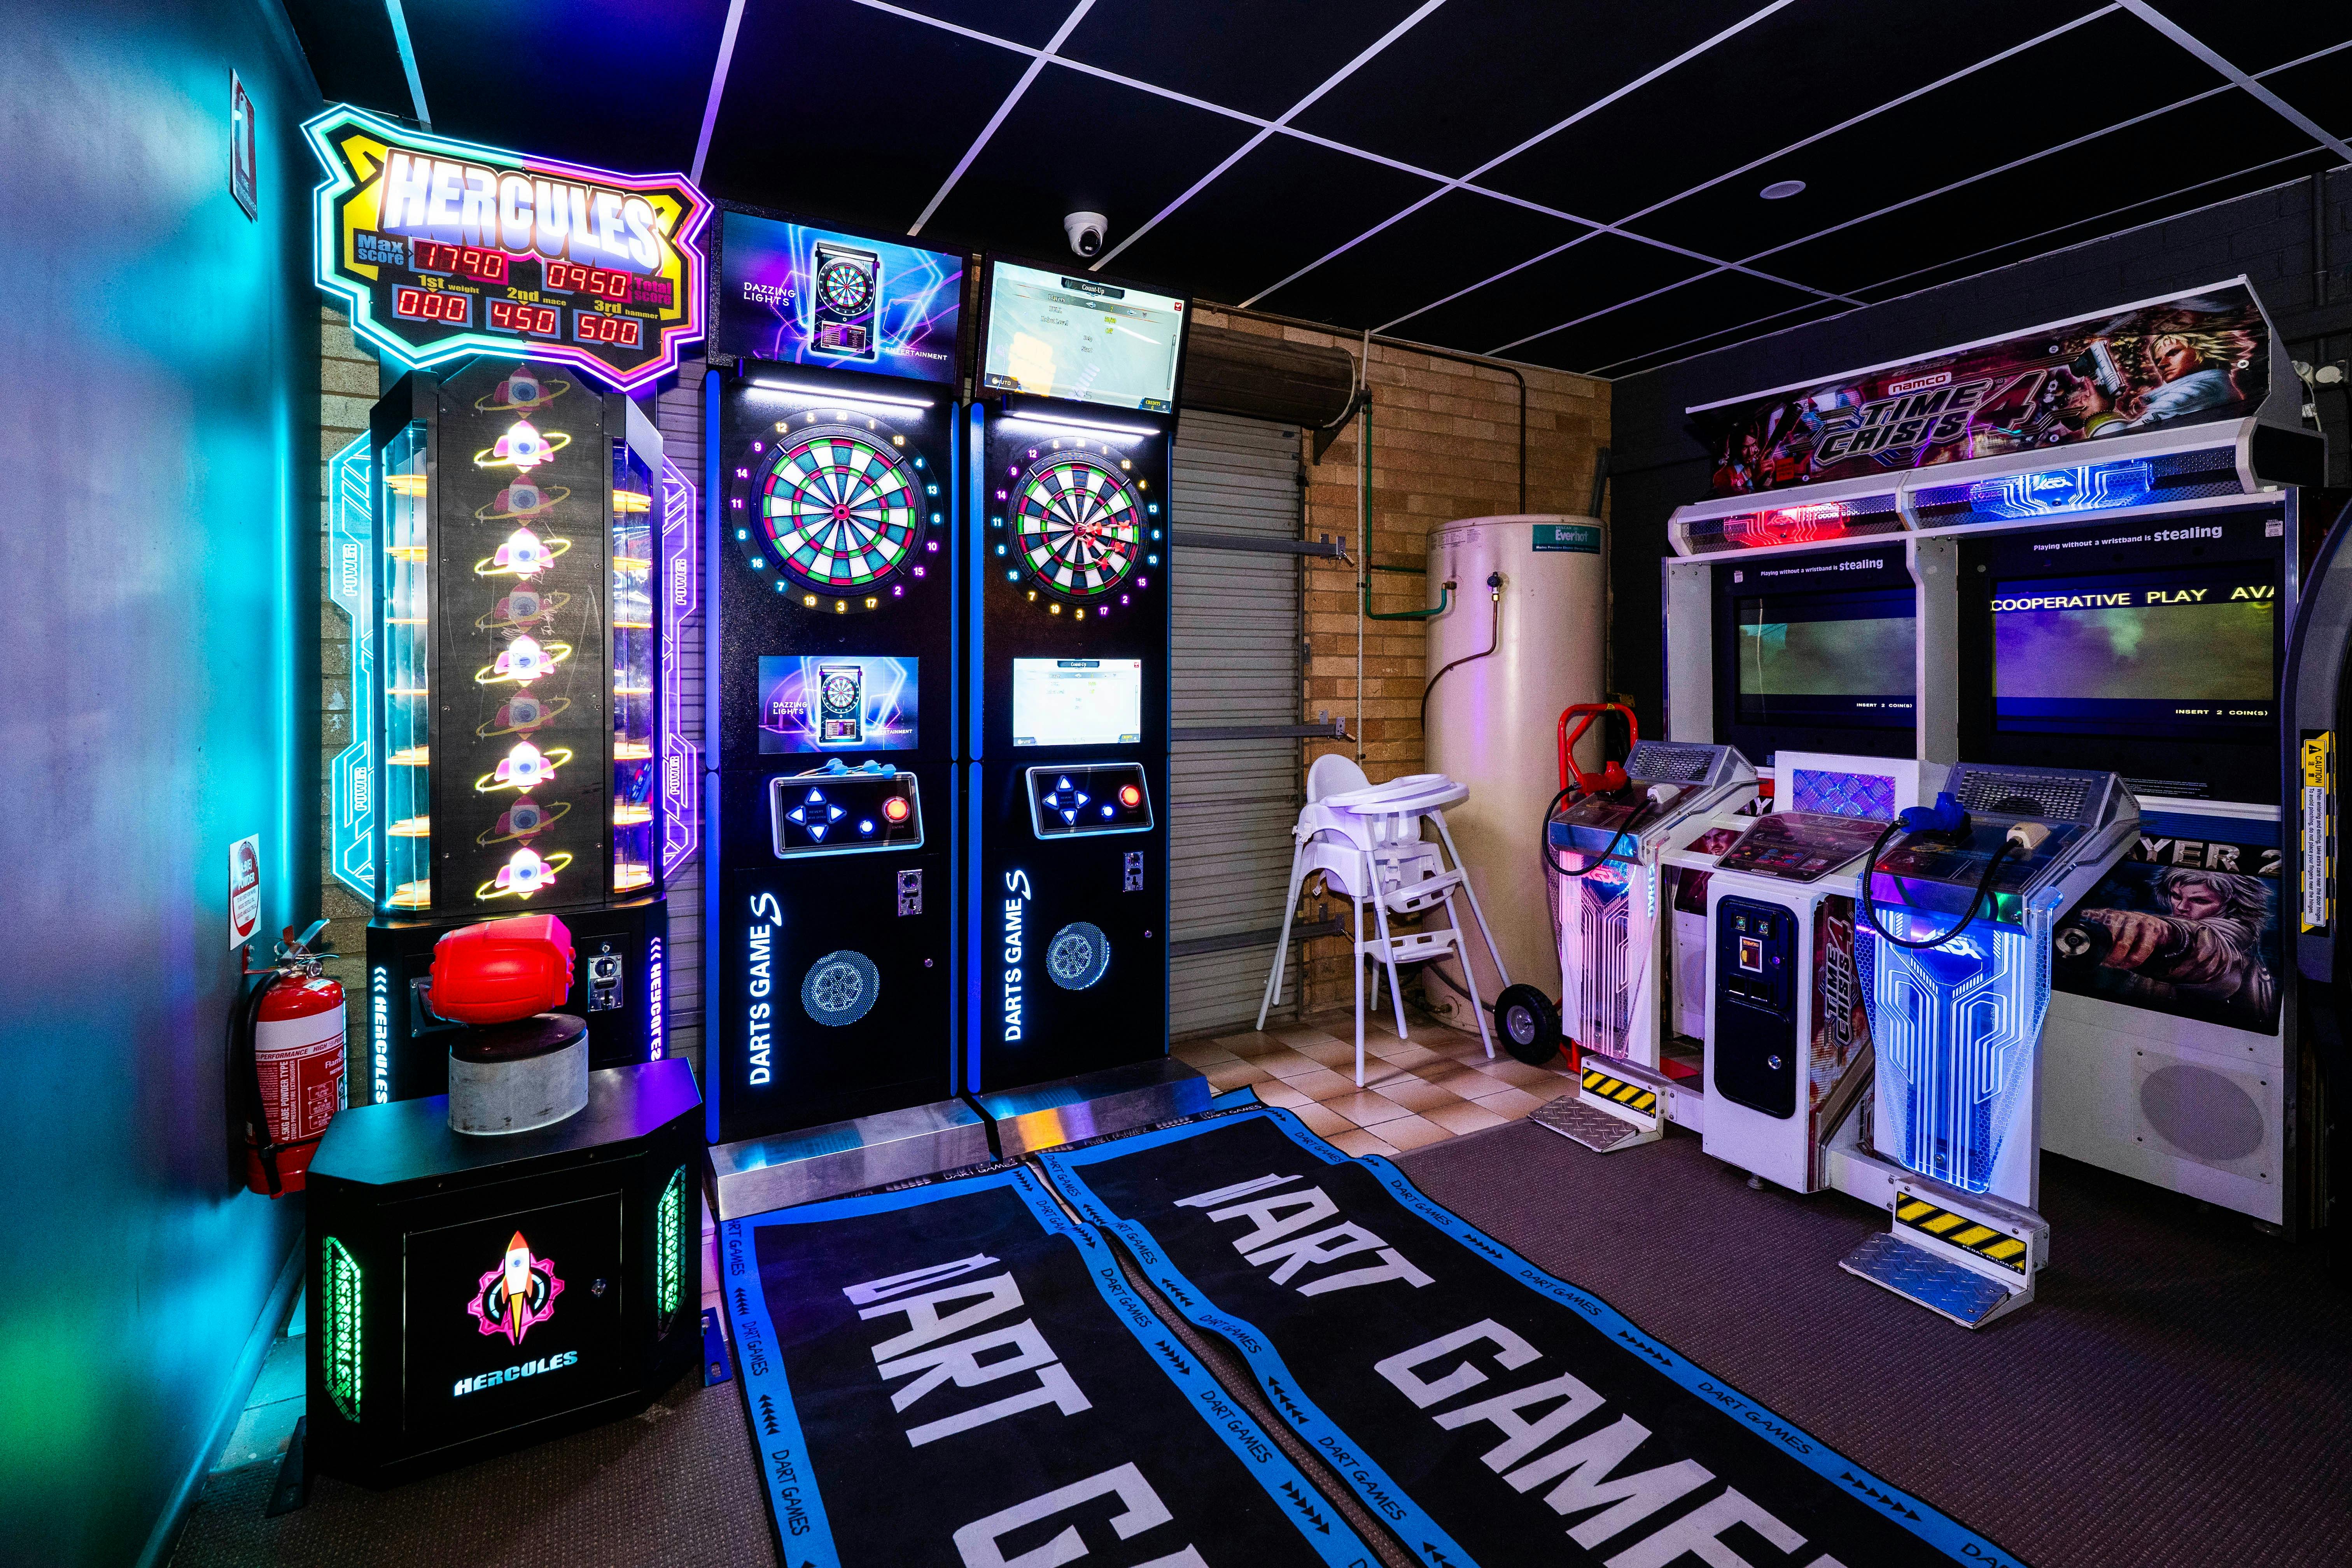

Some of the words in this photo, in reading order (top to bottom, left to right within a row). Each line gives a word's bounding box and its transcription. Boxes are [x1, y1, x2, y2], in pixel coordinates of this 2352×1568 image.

[380, 148, 663, 275] HERCULES
[357, 234, 403, 254] Max
[358, 249, 404, 266] score
[426, 244, 503, 278] 1790
[418, 275, 444, 290] 1st
[448, 284, 479, 295] weight
[548, 264, 626, 297] 0950
[634, 276, 672, 295] Total
[744, 282, 796, 298] DAZZING
[1082, 284, 1105, 294] Count-Up
[399, 290, 466, 322] 000
[507, 287, 539, 303] 2nd
[542, 298, 566, 307] mace
[634, 289, 672, 305] score
[744, 291, 789, 306] LIGHTS
[1048, 294, 1065, 303] Players
[494, 303, 554, 334] 450
[594, 300, 622, 314] 3rd
[625, 310, 658, 320] hammer
[1041, 316, 1055, 324] Robot
[581, 314, 638, 346] 500
[885, 346, 947, 361] ENTERTAINMENT
[1892, 374, 1947, 393] namco
[1861, 379, 1993, 426] TIME
[1972, 369, 2047, 436] 4
[776, 424, 787, 432] 12
[1815, 410, 1975, 466] CRISIS
[754, 443, 761, 451] 9
[737, 469, 747, 478] 14
[916, 459, 922, 467] 4
[1556, 529, 1588, 541] Everhot
[2034, 543, 2060, 551] Playing
[2062, 540, 2092, 548] without
[2101, 535, 2142, 544] wristband
[2154, 525, 2222, 542] stealing
[343, 543, 357, 597] POWER
[1839, 558, 1883, 571] stealing
[675, 558, 688, 605] POWER
[1991, 593, 2130, 611] COOPERATIVE
[2147, 588, 2208, 604] PLAY
[670, 756, 681, 796] POWER
[354, 767, 367, 811] POWER
[2258, 849, 2282, 876] 2
[238, 872, 255, 890] POWDER
[1828, 916, 1853, 955] 4
[1825, 943, 1839, 1019] TIME
[1005, 968, 1022, 1042] DARTS
[1836, 951, 1853, 1045] CRISIS
[260, 1048, 308, 1060] PERFORMANCE
[313, 1043, 327, 1052] HIGH
[374, 996, 388, 1104] HERCULES
[750, 1003, 770, 1085] DARTS
[280, 1061, 289, 1078] TYPE
[280, 1079, 289, 1106] POWDER
[280, 1108, 289, 1120] ABE
[1634, 1107, 1650, 1115] RELOAD
[280, 1122, 290, 1141] 4.5KG
[730, 1220, 742, 1237] ART
[730, 1237, 745, 1276] GAMES
[1962, 1244, 1984, 1257] PEDAL
[1986, 1255, 2015, 1269] RELOAD
[1101, 1268, 1127, 1302] DART
[1119, 1296, 1153, 1328] GAMES
[453, 1350, 578, 1397] HERCULES
[1200, 1390, 1236, 1421] DART
[1227, 1416, 1273, 1464] GAMES
[1697, 1381, 1747, 1411] DART
[1745, 1411, 1814, 1455] GAMES
[772, 1449, 796, 1486] DART
[1318, 1436, 1360, 1471] DART
[1352, 1468, 1407, 1521] GAMES
[781, 1484, 811, 1536] GAMES
